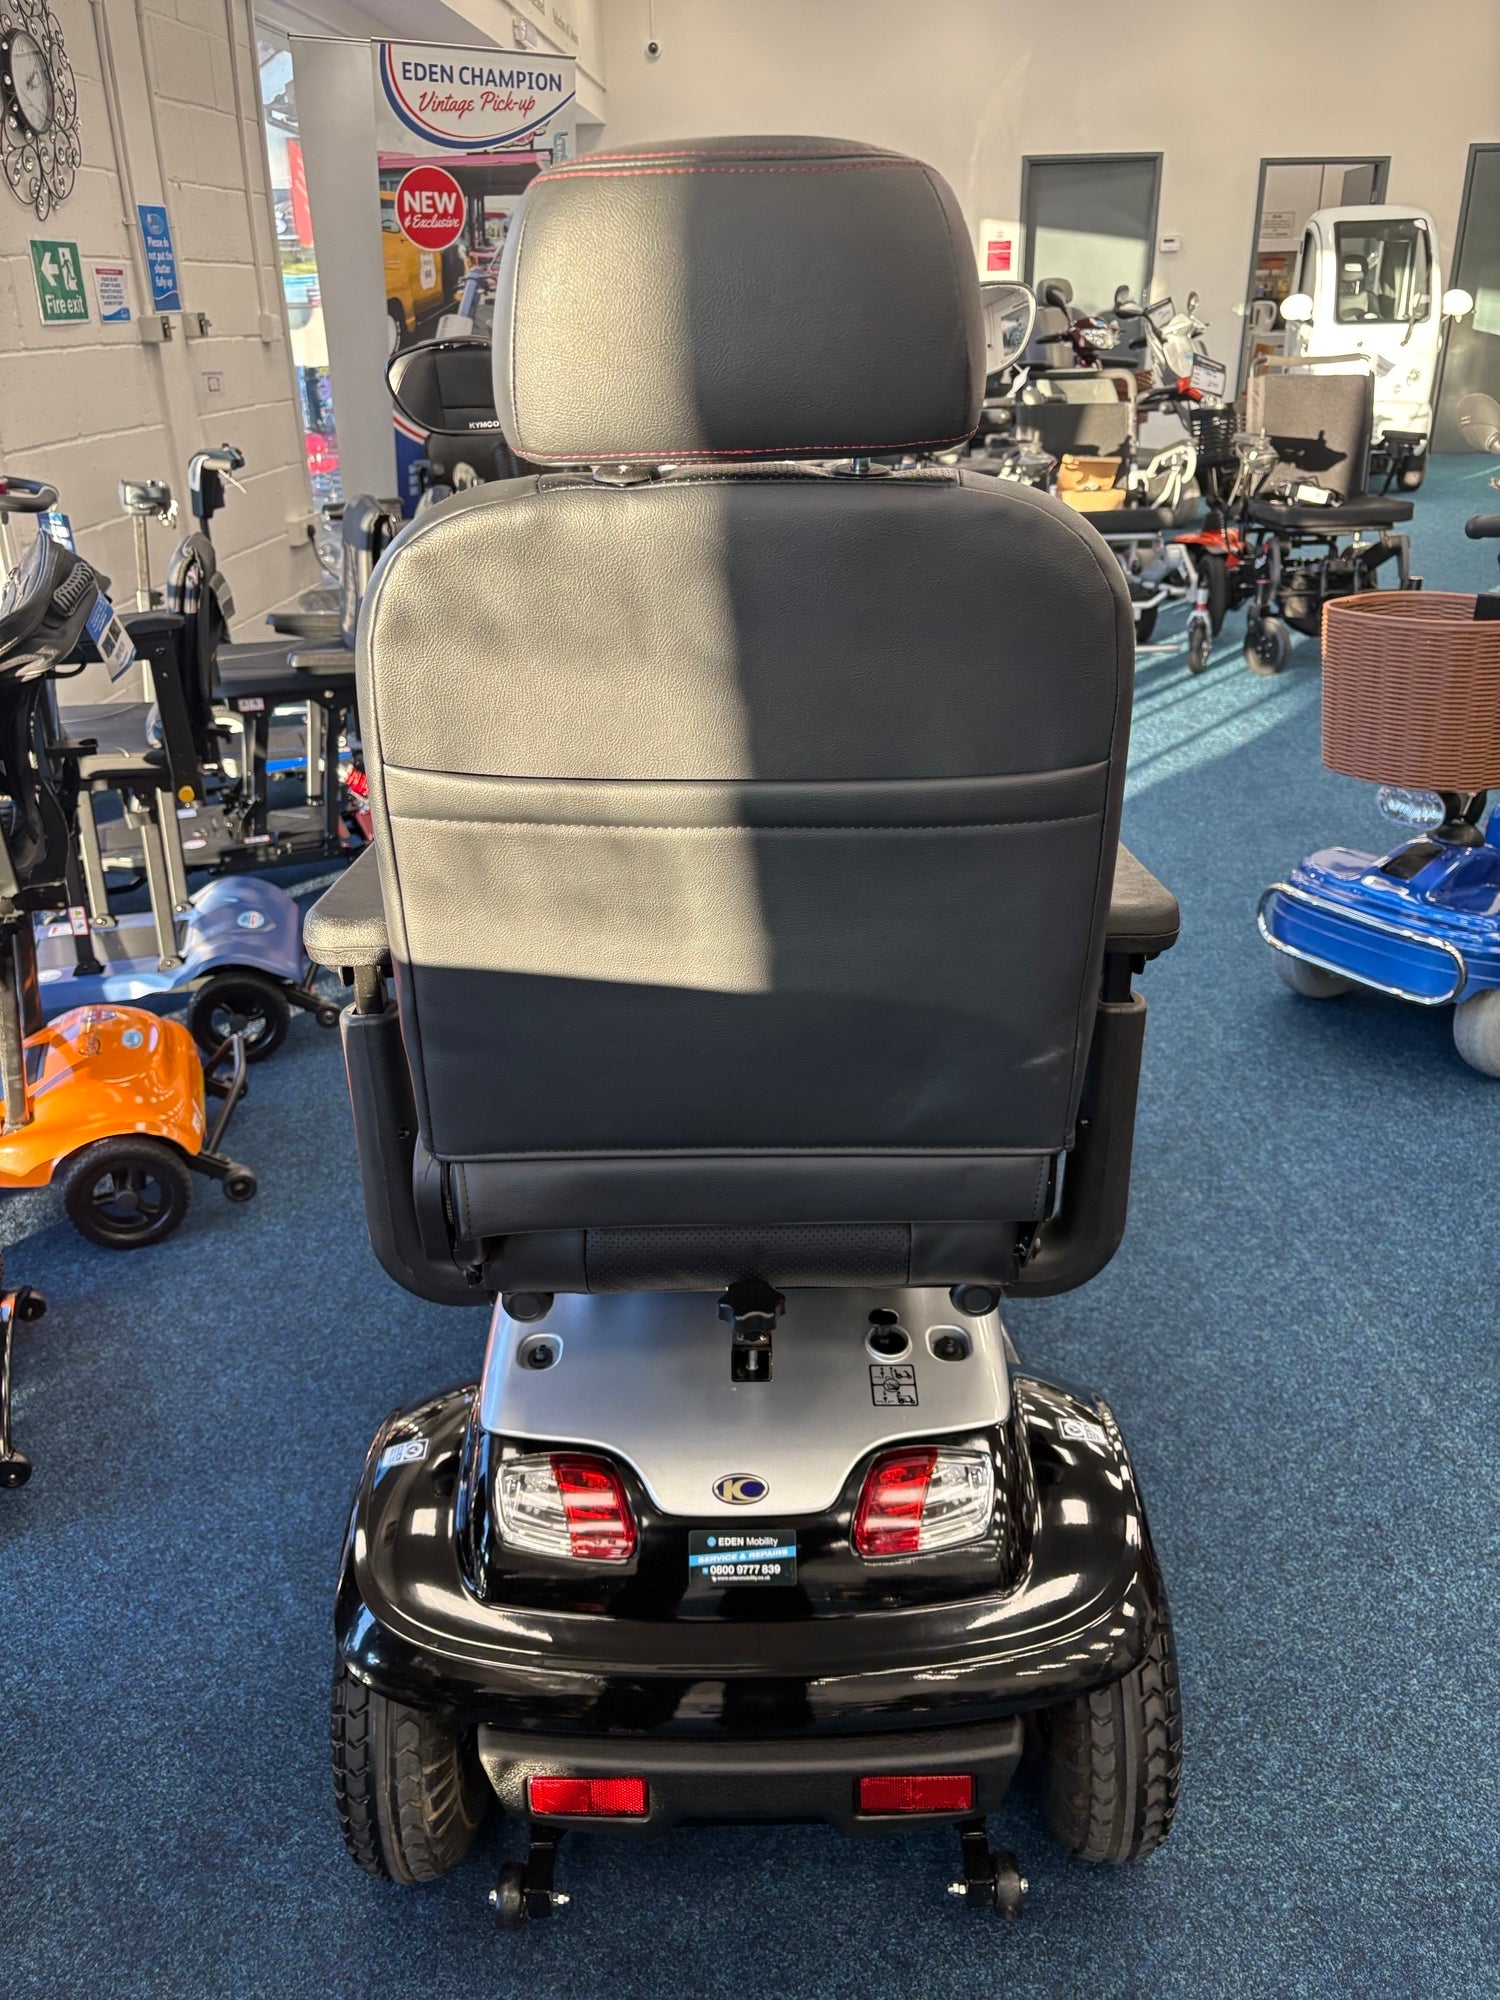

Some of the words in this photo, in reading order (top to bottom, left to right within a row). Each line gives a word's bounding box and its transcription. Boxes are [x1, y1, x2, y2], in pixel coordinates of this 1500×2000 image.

[402, 61, 454, 84] EDEN
[459, 66, 562, 92] CHAMPION
[419, 91, 475, 119] Vintage
[480, 91, 536, 118] Pick-up
[403, 190, 457, 214] NEW
[412, 213, 460, 229] Exclusive
[44, 294, 67, 314] Fire
[67, 295, 85, 314] exit
[469, 420, 500, 429] KYMCO
[718, 1537, 744, 1546] EDEN
[746, 1536, 778, 1548] Mobility
[698, 1553, 738, 1563] SERVICE
[748, 1549, 788, 1559] REPAIRS
[710, 1565, 735, 1575] 0800
[737, 1565, 760, 1575] 9777
[761, 1564, 781, 1574] 839
